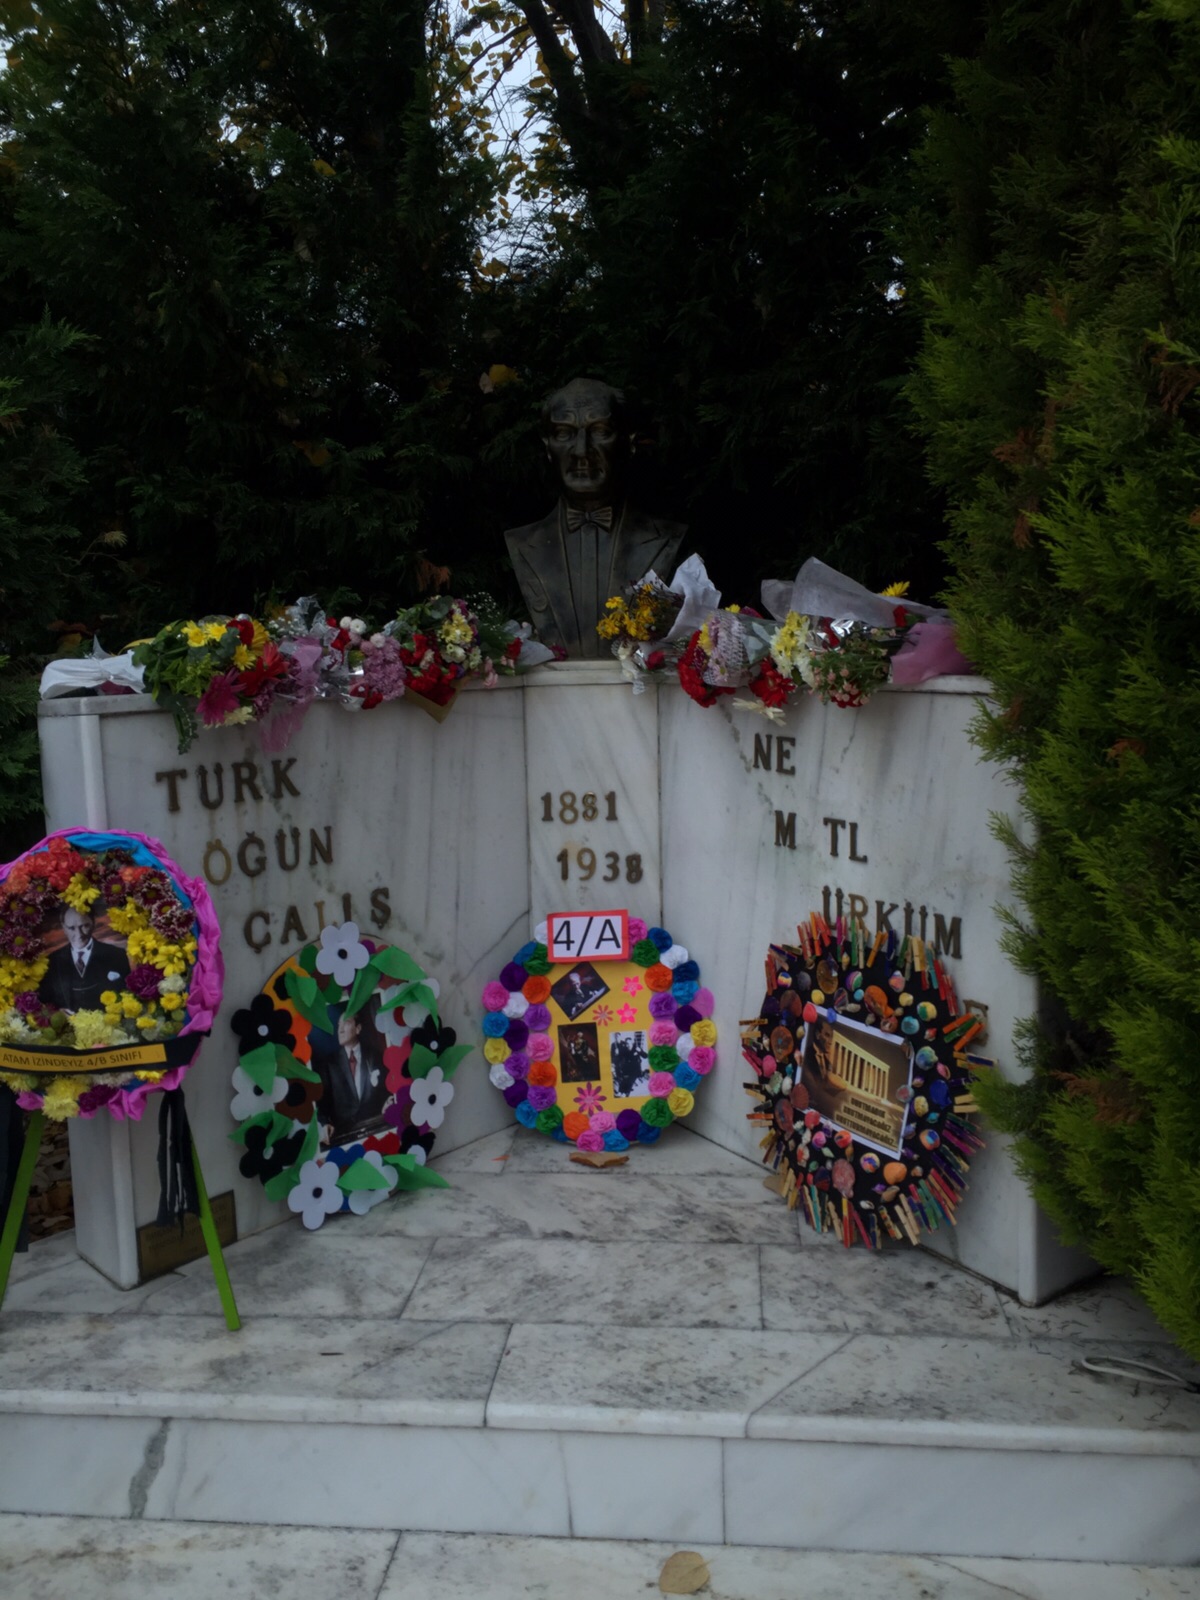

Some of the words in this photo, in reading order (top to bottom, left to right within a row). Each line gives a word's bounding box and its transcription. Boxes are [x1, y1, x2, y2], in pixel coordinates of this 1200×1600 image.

[753, 732, 796, 775] NE
[541, 791, 618, 824] 1881
[557, 847, 643, 884] 1938
[553, 916, 621, 957] 4/A
[3, 1053, 30, 1065] ATAM
[86, 1055, 106, 1066] 4/B
